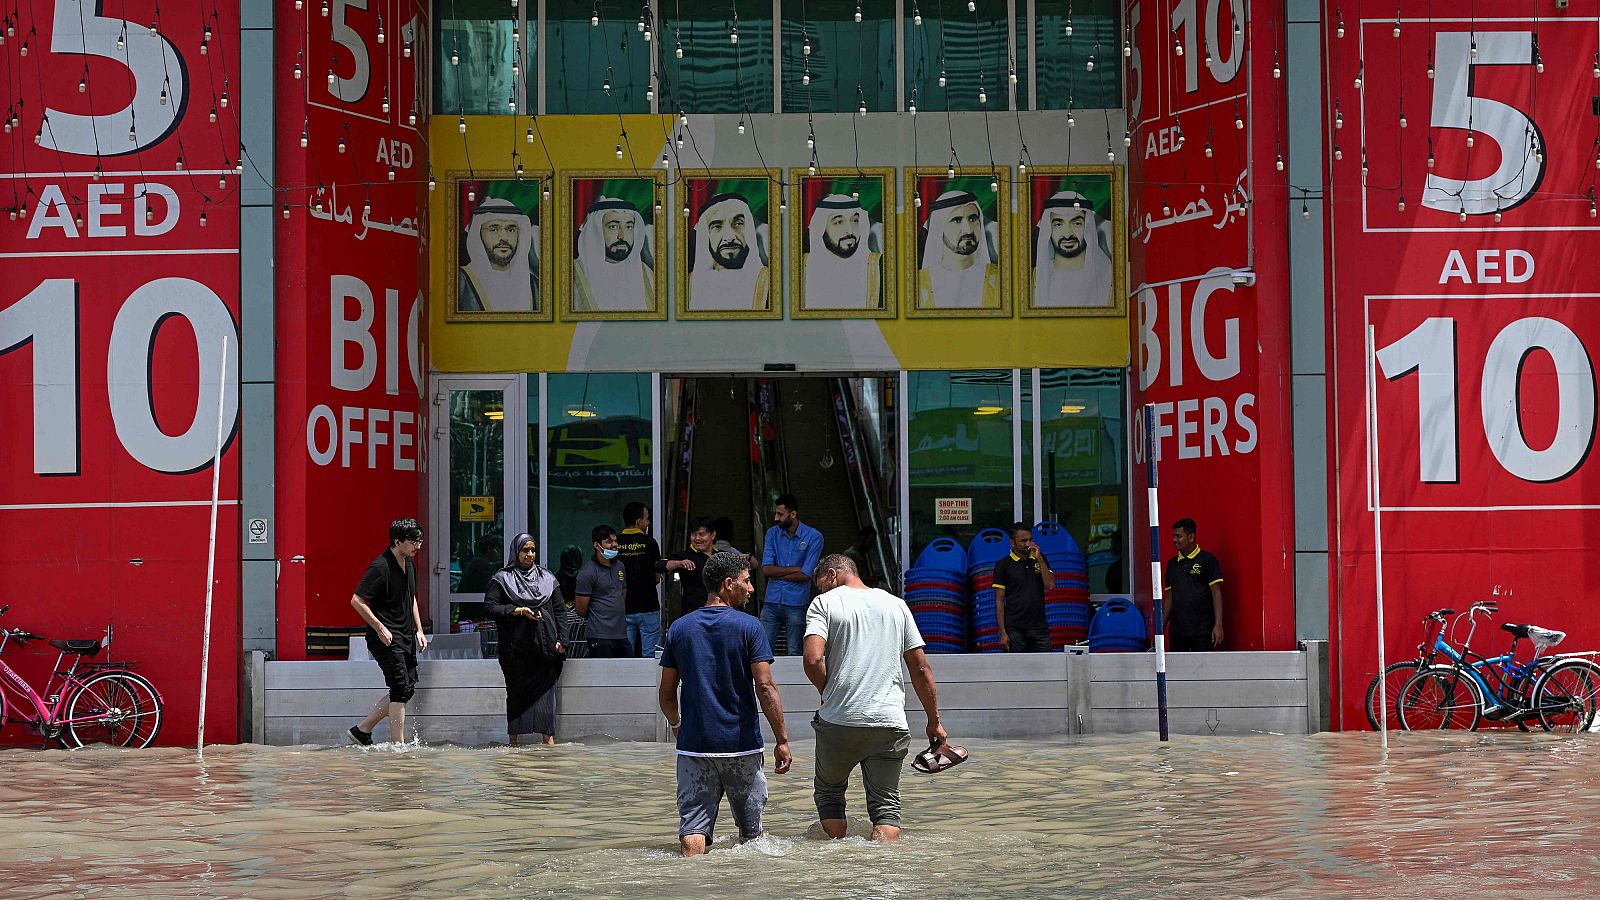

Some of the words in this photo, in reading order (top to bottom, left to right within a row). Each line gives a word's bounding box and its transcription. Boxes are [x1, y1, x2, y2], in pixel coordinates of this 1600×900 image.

[37, 0, 189, 156] 5
[327, 0, 371, 103] 5
[1172, 0, 1246, 94] 10
[376, 137, 413, 169] AED
[1145, 126, 1183, 160] AED
[1421, 31, 1546, 215] 5
[26, 183, 181, 239] AED
[1438, 249, 1536, 284] AED
[0, 276, 239, 475] 10
[1137, 267, 1240, 391] BIG
[1134, 393, 1257, 465] OFERS
[1376, 316, 1597, 483] 10
